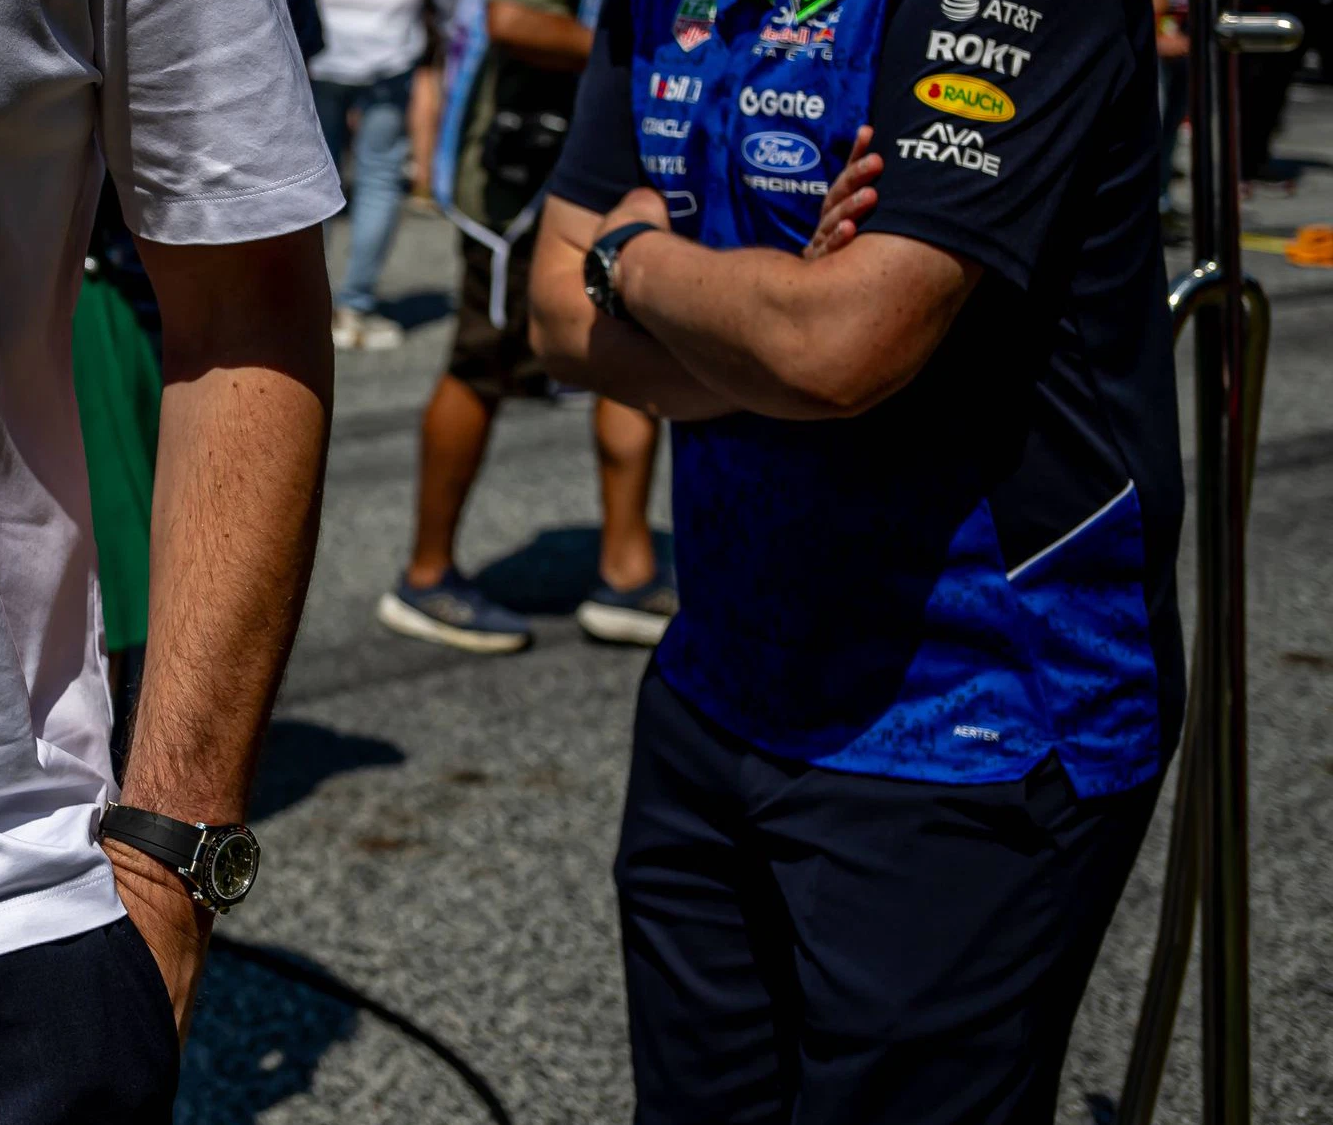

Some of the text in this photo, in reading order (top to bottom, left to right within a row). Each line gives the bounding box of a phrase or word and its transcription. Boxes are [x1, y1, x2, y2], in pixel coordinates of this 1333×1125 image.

[925, 29, 1032, 78] ROKT
[943, 84, 1004, 115] RAUCH
[921, 121, 985, 149] AVA
[753, 137, 815, 168] Ford
[896, 138, 1002, 178] TRADE
